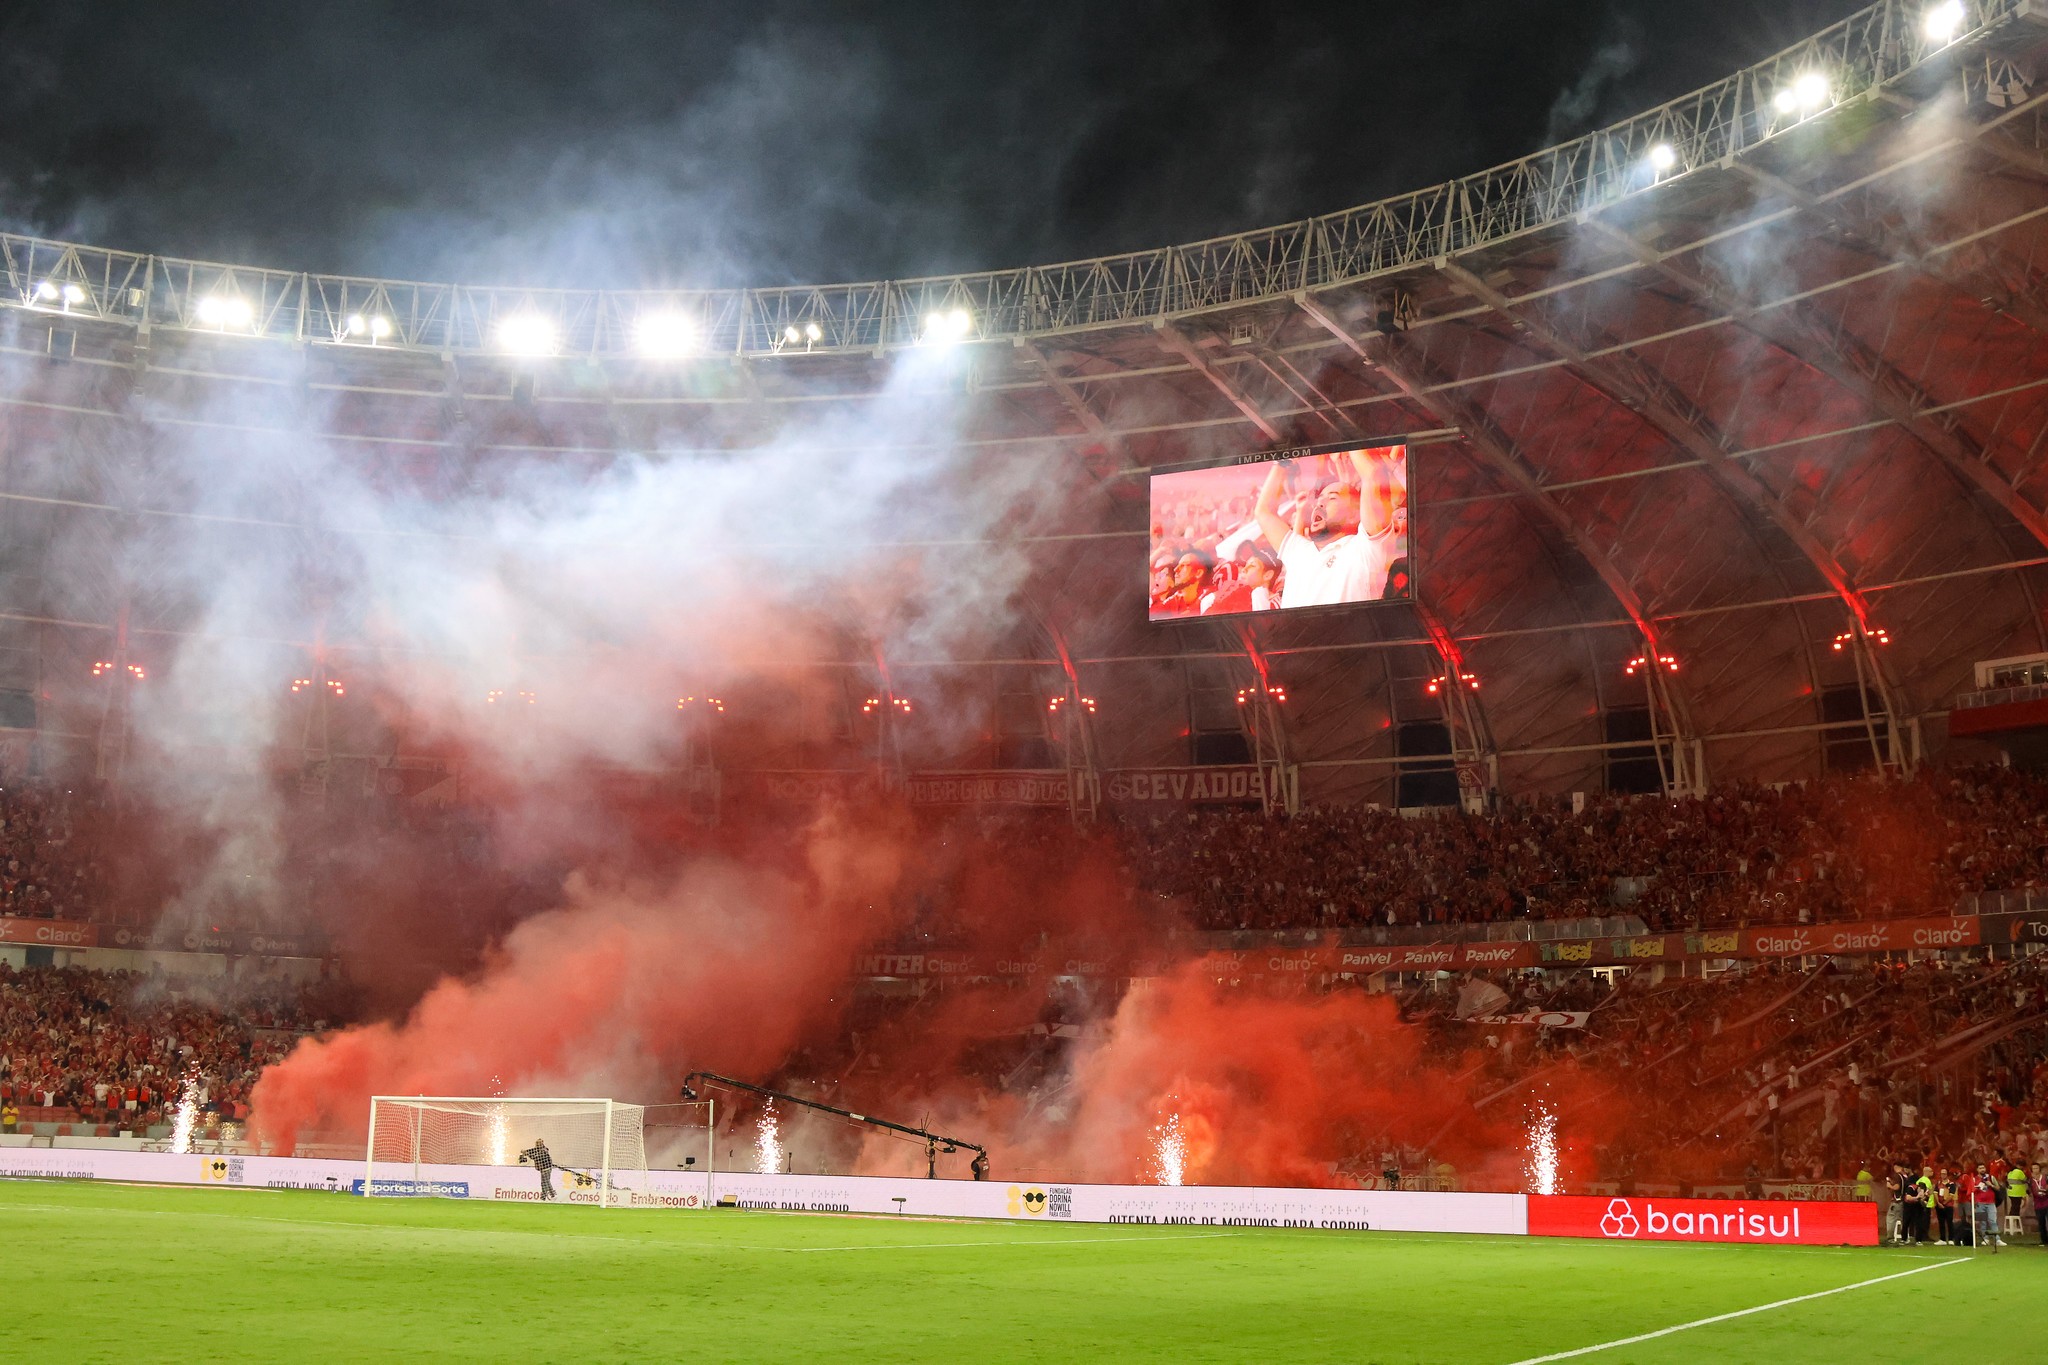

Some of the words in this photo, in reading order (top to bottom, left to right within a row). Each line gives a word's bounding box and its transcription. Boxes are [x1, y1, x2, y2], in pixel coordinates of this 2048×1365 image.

[1238, 448, 1311, 464] IMPLY.COM
[1131, 772, 1266, 800] CEVADOS
[37, 926, 81, 942] Claro
[1832, 932, 1880, 949] Claro
[1913, 928, 1962, 945] Claro
[1756, 936, 1801, 953] Claro
[1342, 952, 1392, 965] PanVel
[1404, 951, 1454, 964] PanVel
[1465, 948, 1516, 961] PanVel
[855, 954, 925, 974] INTER
[928, 957, 968, 973] Claro
[997, 957, 1036, 973] Claro
[1201, 957, 1240, 972] Claro
[1269, 956, 1311, 971] Claro
[415, 1184, 430, 1193] da
[432, 1184, 465, 1194] Sorte
[569, 1191, 618, 1203] Consóio
[631, 1193, 686, 1206] Embracon
[1050, 1194, 1071, 1203] DORINA
[1049, 1203, 1071, 1211] NOWILL
[1647, 1204, 1799, 1237] banrisul
